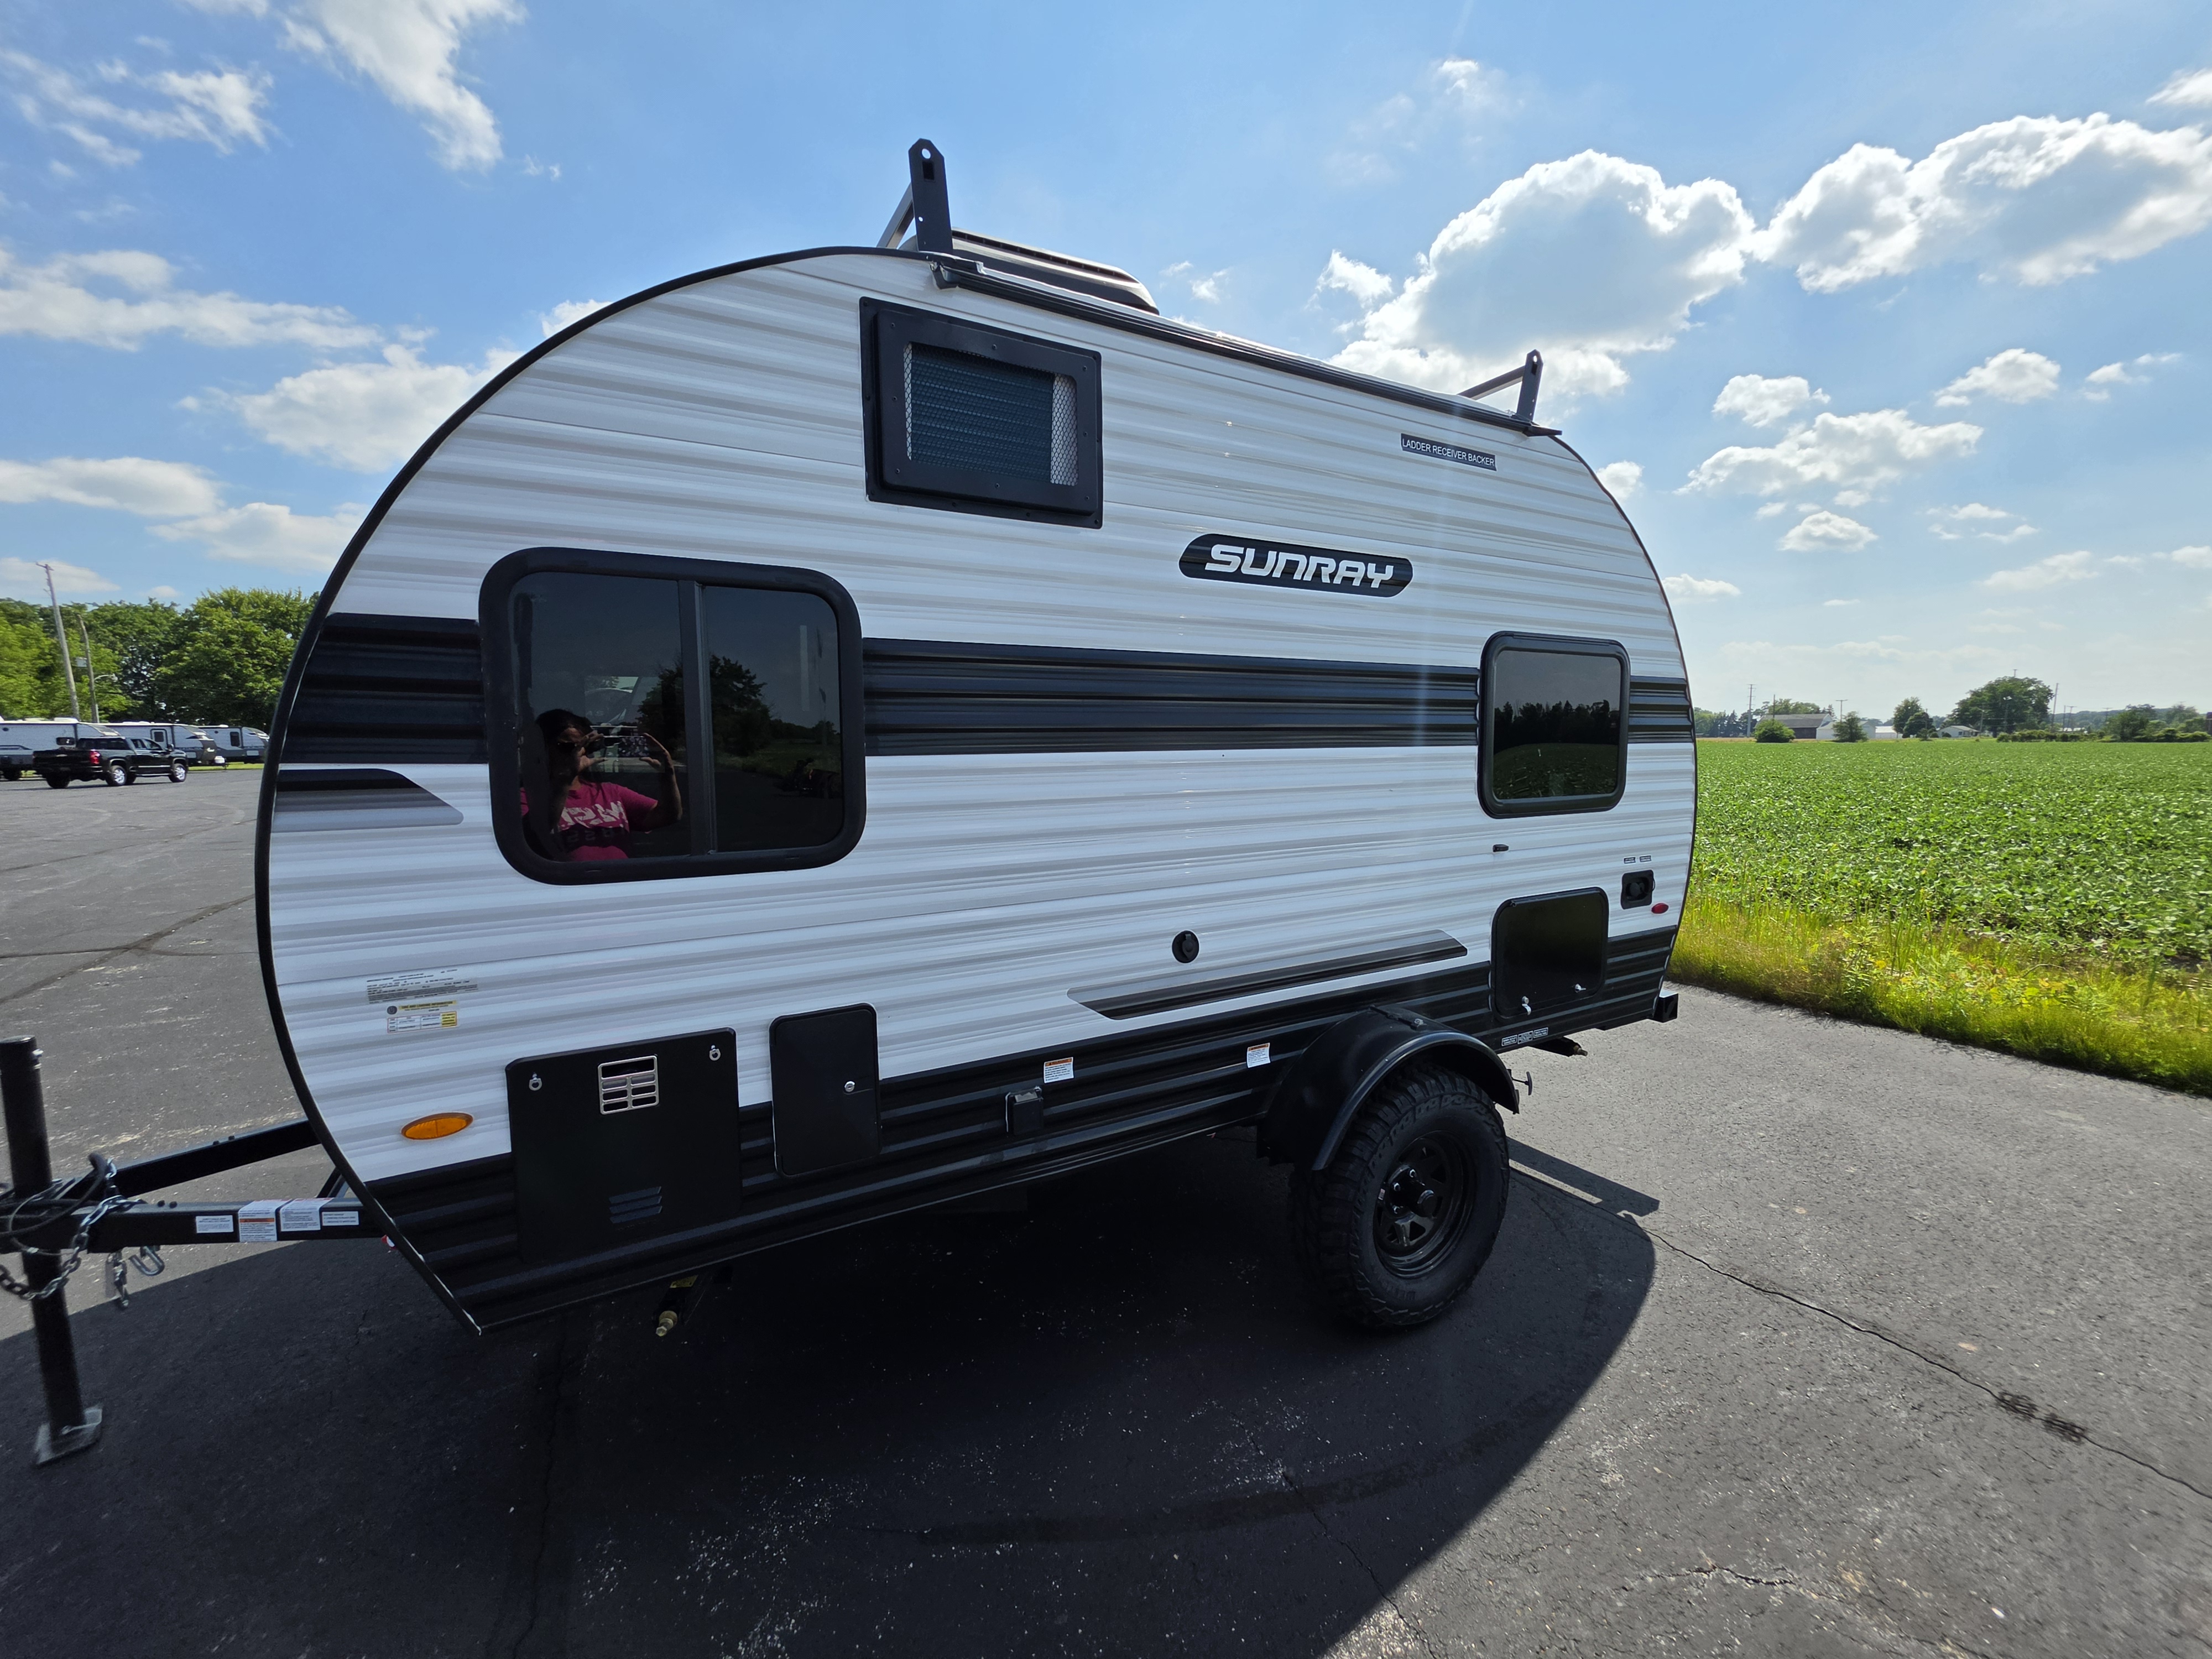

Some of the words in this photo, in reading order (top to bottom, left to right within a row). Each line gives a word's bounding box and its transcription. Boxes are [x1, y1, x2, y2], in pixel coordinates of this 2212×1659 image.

[1402, 439, 1431, 452] LADDER
[1432, 445, 1467, 460] RECEIVER
[1468, 453, 1494, 466] BACKER
[1205, 544, 1394, 588] SUNRAY
